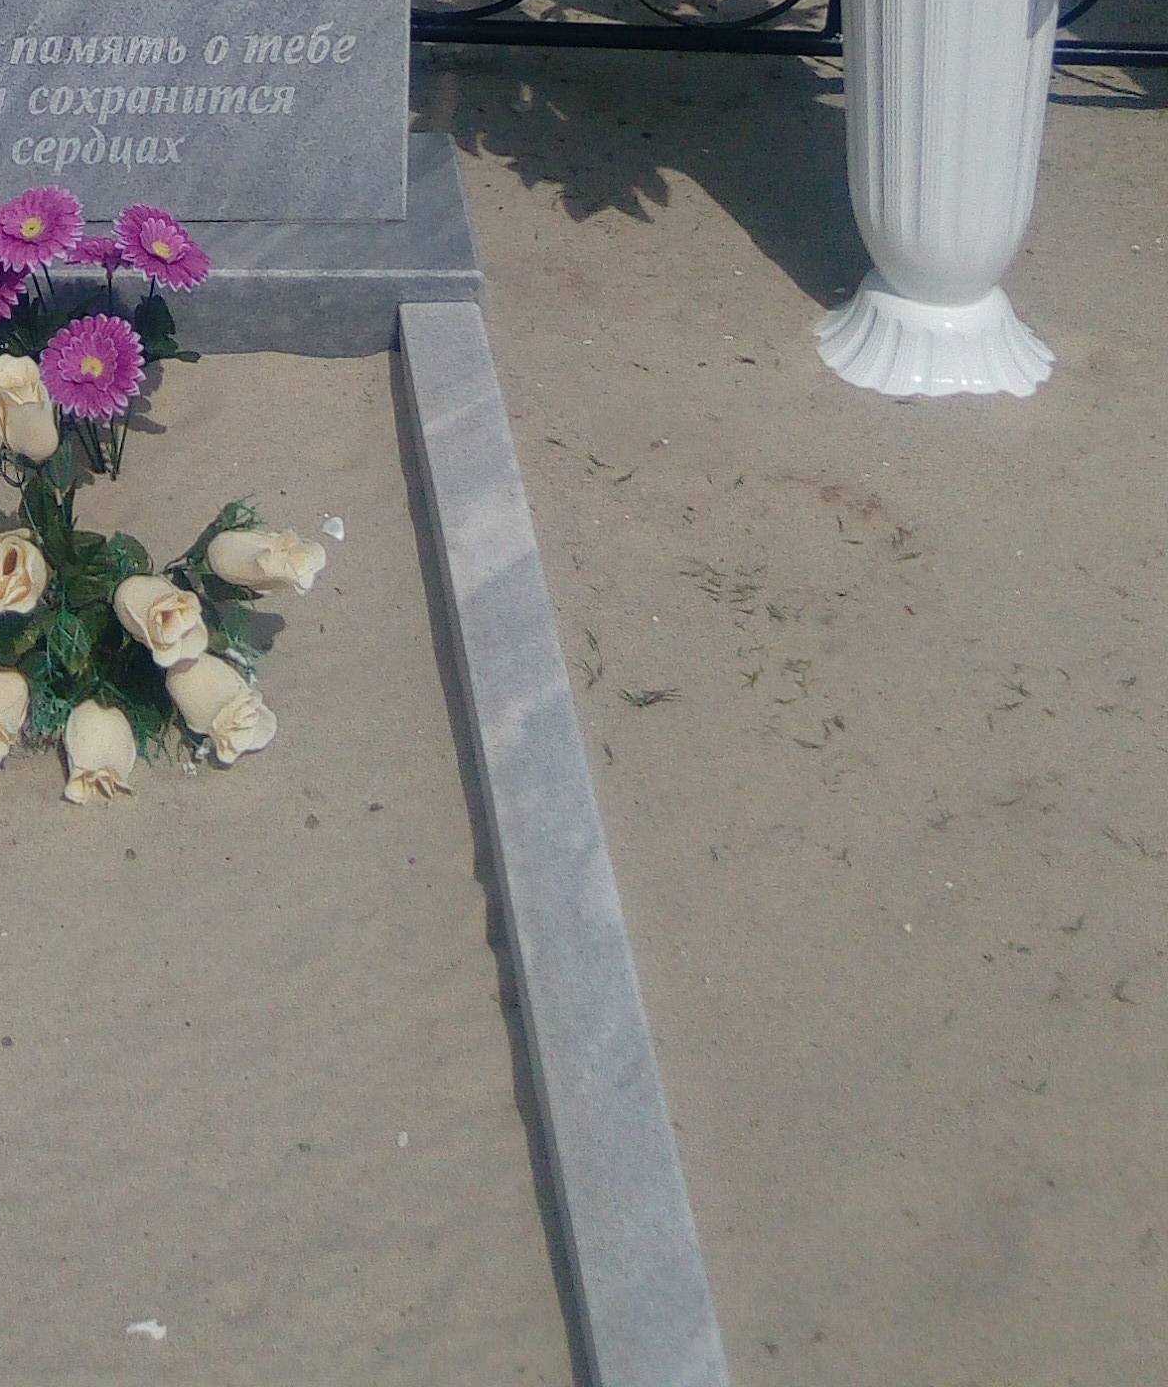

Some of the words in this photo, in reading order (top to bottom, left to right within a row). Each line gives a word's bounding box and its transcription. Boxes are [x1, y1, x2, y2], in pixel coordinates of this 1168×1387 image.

[8, 31, 188, 66] память
[203, 40, 229, 65] о
[243, 20, 358, 64] тебе
[27, 83, 298, 123] сохранится
[11, 127, 183, 174] сердцах
